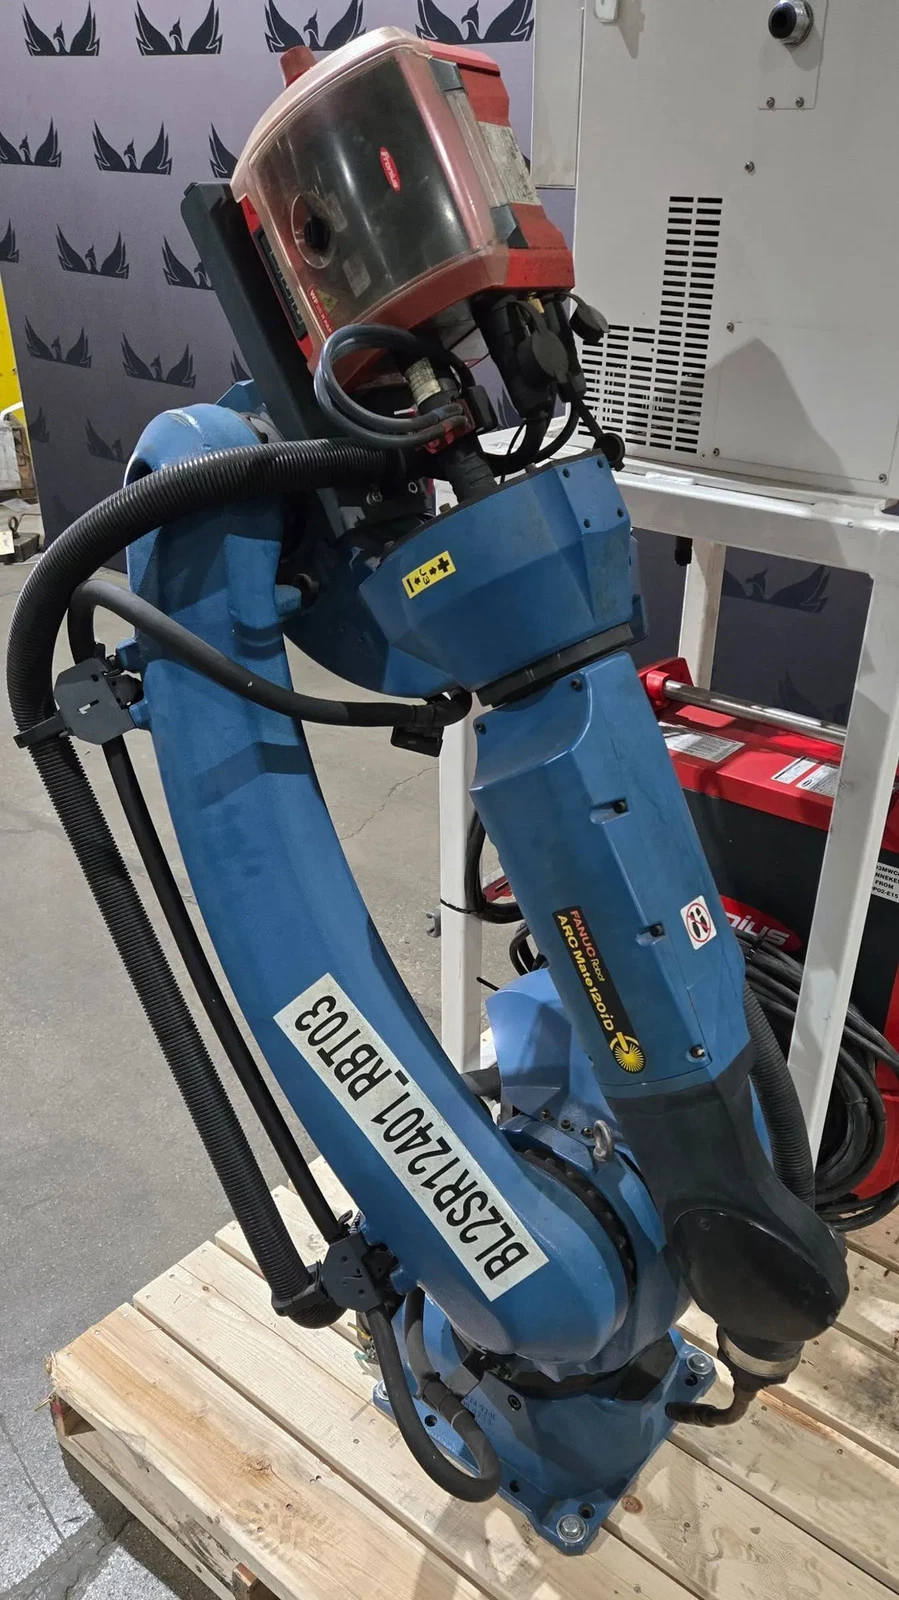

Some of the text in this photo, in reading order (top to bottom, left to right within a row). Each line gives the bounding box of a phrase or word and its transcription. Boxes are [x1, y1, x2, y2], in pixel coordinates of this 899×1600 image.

[380, 151, 399, 189] Fronius
[419, 568, 430, 585] J3
[557, 914, 579, 949] ARC
[570, 909, 605, 982] FANUC Robot
[294, 995, 530, 1281] BL2SR12401_RBT03
